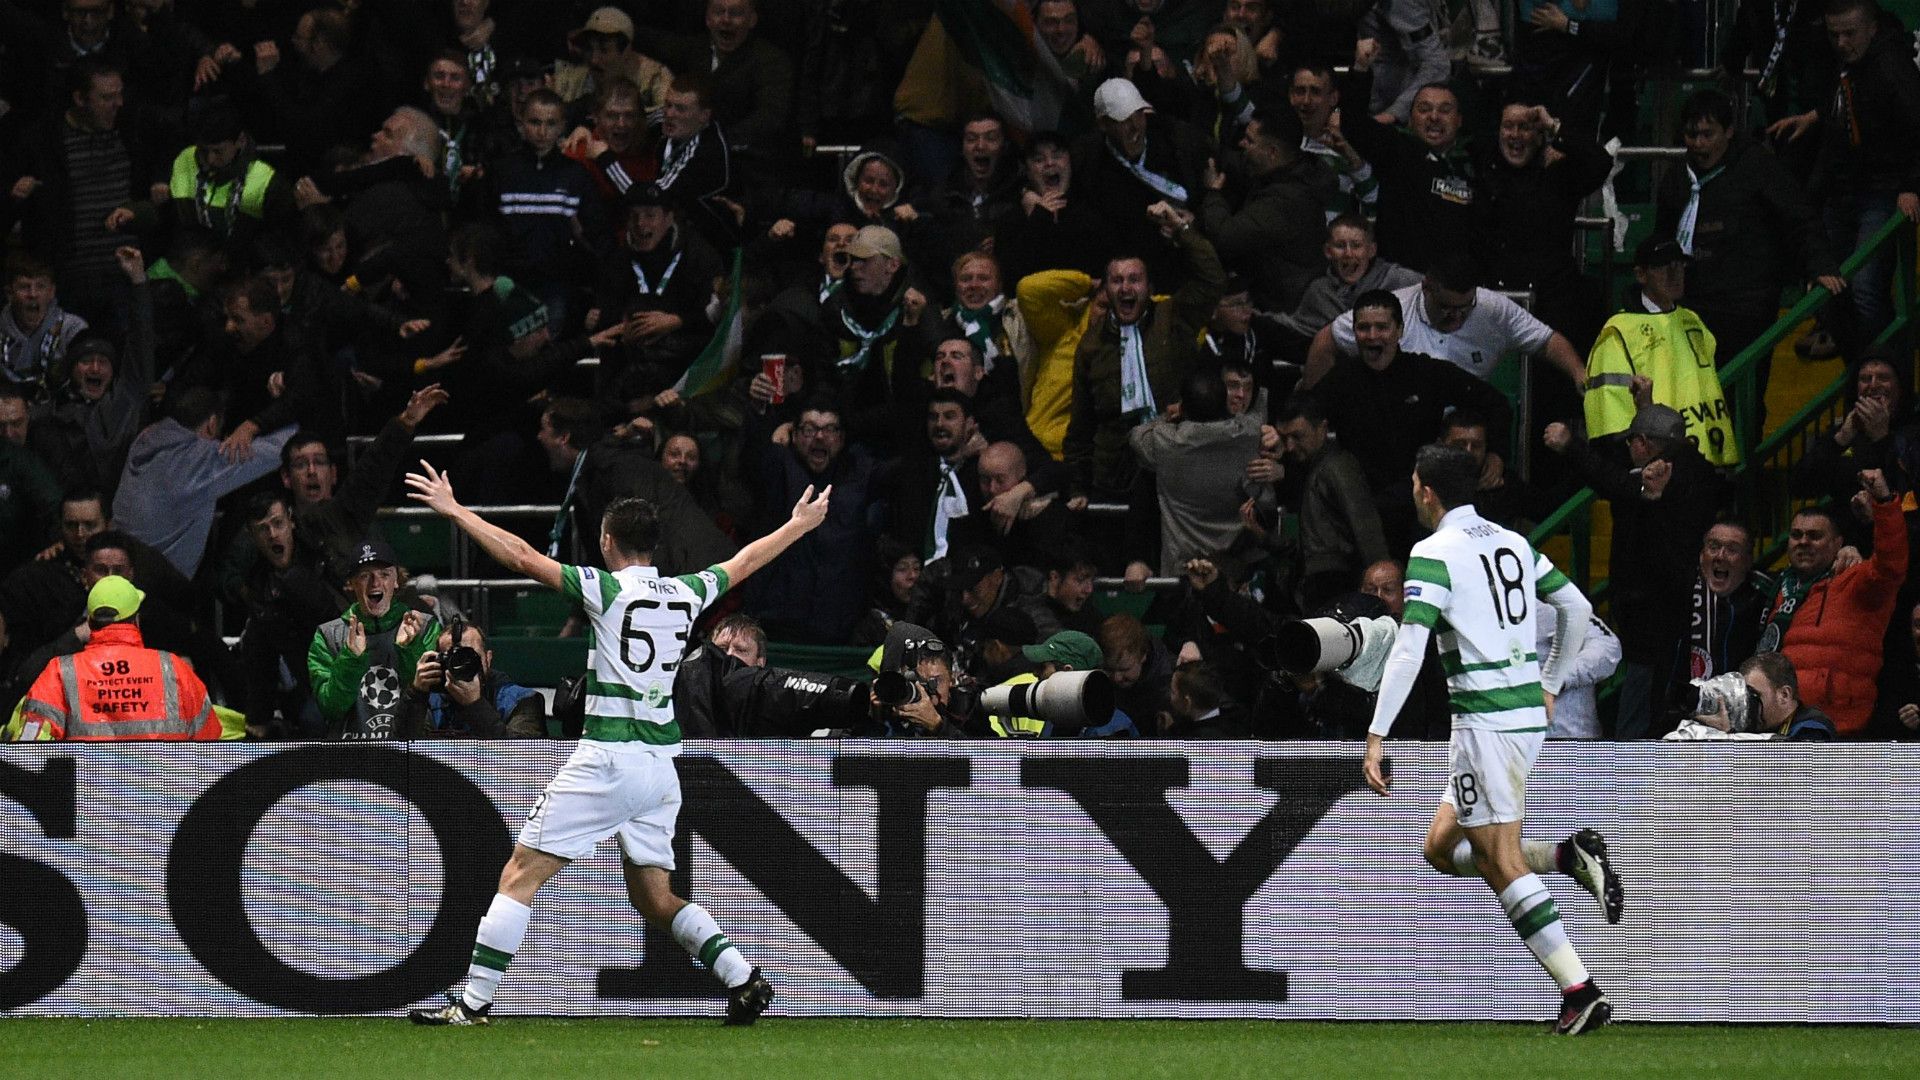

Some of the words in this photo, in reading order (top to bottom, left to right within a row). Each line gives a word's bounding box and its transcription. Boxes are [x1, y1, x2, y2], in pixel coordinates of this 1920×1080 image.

[1479, 547, 1527, 629] 18
[620, 599, 692, 673] 63
[101, 660, 130, 676] 98
[126, 677, 154, 685] EVENT
[783, 676, 828, 693] Nikon
[97, 688, 142, 699] PITCH
[92, 701, 149, 714] SAFETY
[1453, 772, 1478, 808] 18
